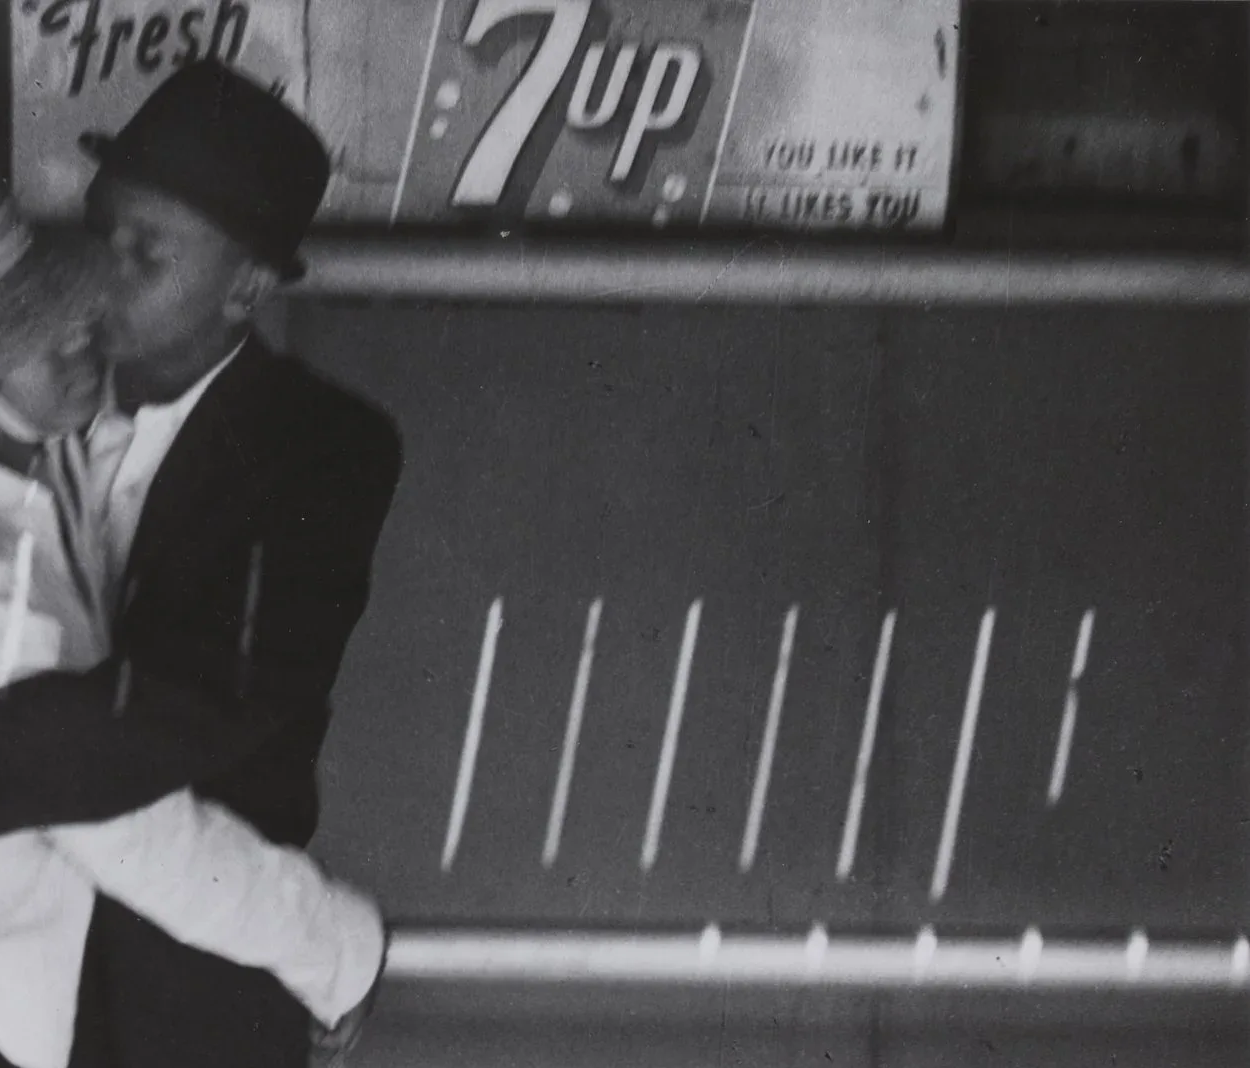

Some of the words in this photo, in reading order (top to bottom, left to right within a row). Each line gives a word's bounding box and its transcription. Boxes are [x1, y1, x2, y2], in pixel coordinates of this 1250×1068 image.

[765, 141, 816, 171] YOU
[826, 141, 882, 171] LIKE
[894, 141, 918, 171] IT
[866, 190, 922, 223] YOU
